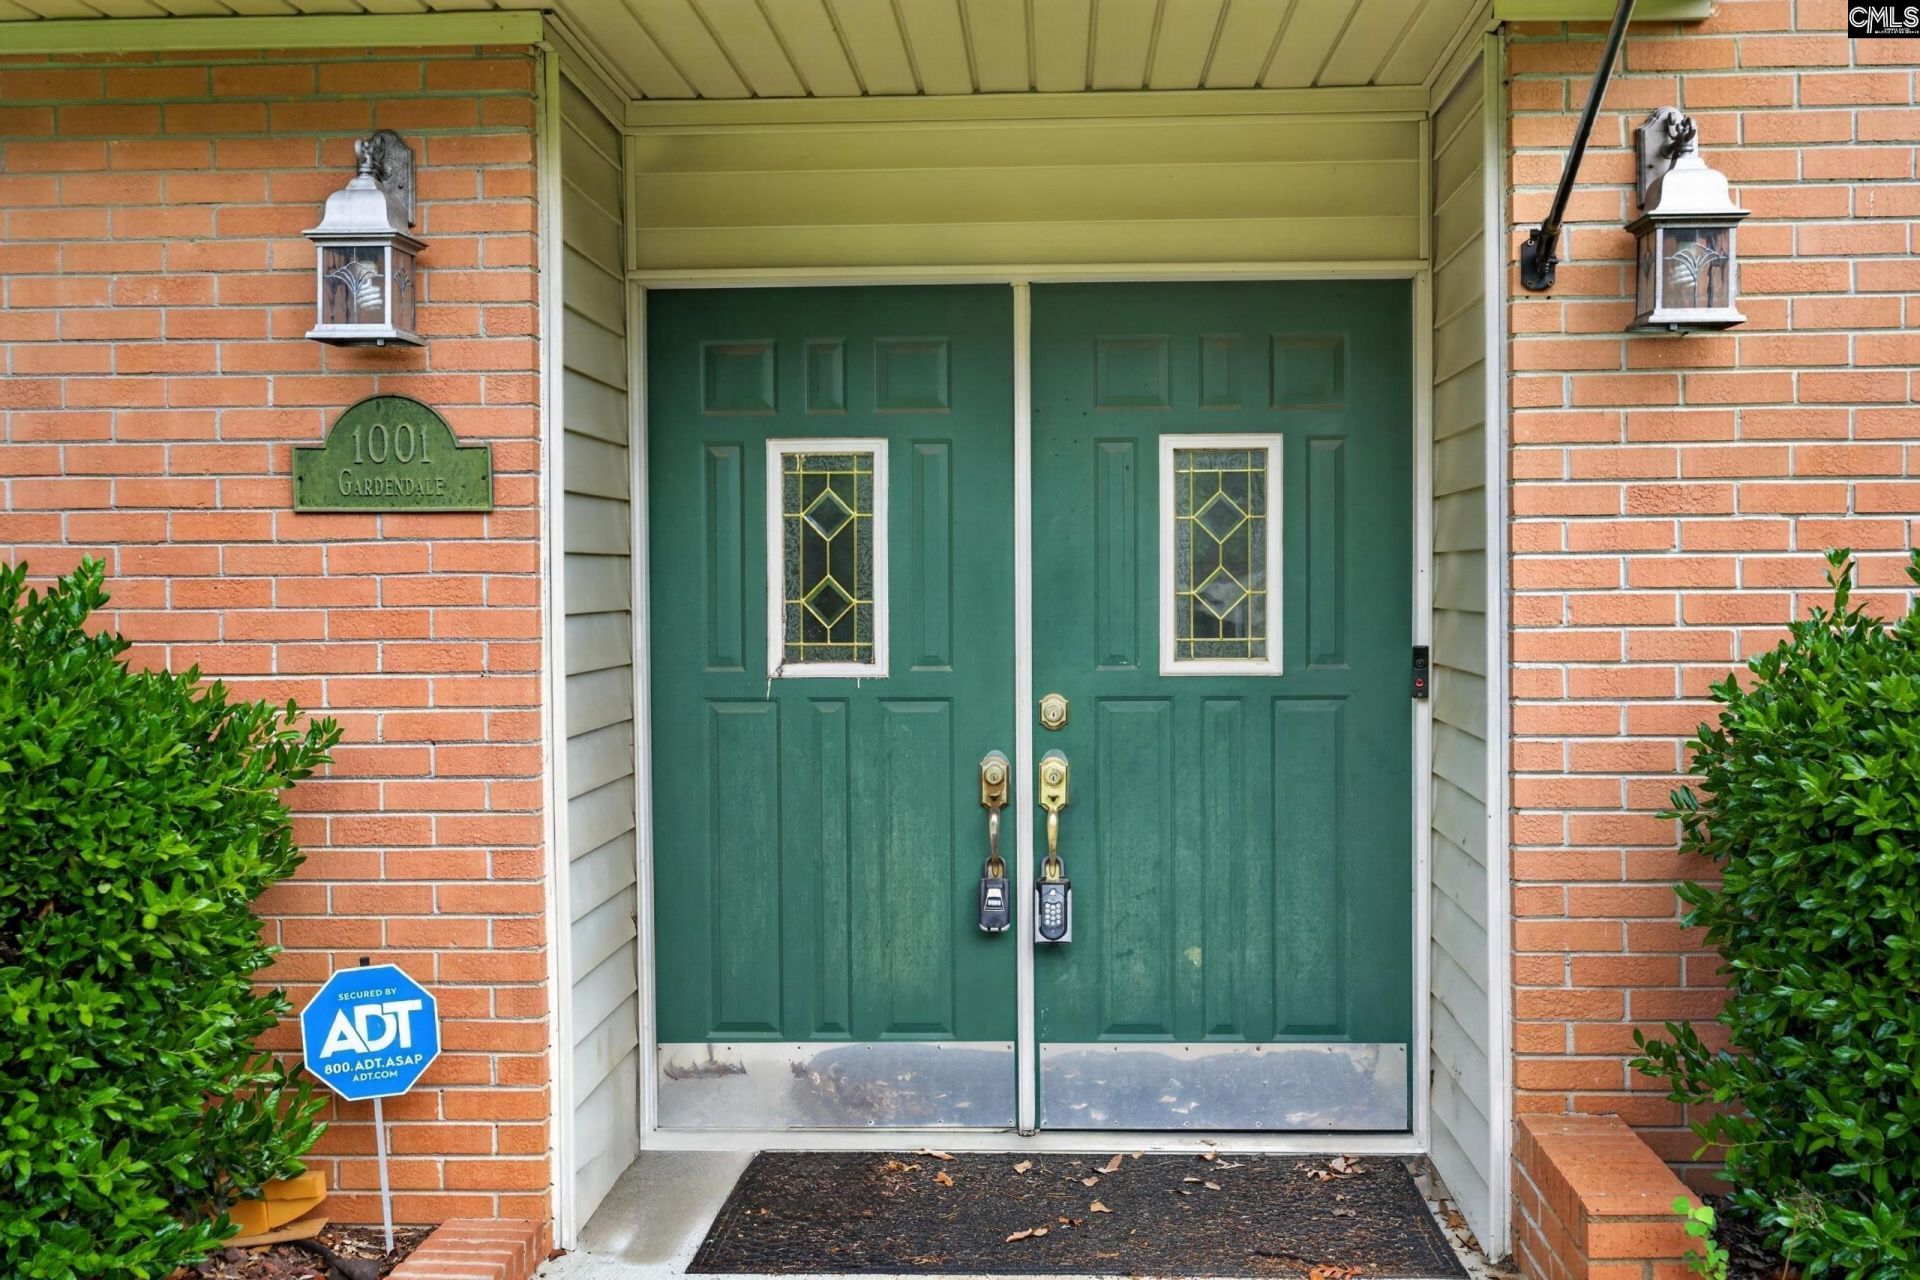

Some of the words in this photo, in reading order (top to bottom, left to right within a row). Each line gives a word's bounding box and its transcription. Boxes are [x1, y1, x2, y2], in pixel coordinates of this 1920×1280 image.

[352, 423, 432, 464] 1001
[338, 468, 445, 497] GARDENDALE
[338, 989, 383, 1001] SECURED
[385, 987, 397, 995] BY
[319, 999, 423, 1059] ADT
[324, 1054, 423, 1075] 800.ADT.ASAP
[352, 1070, 398, 1082] ADT.COM
